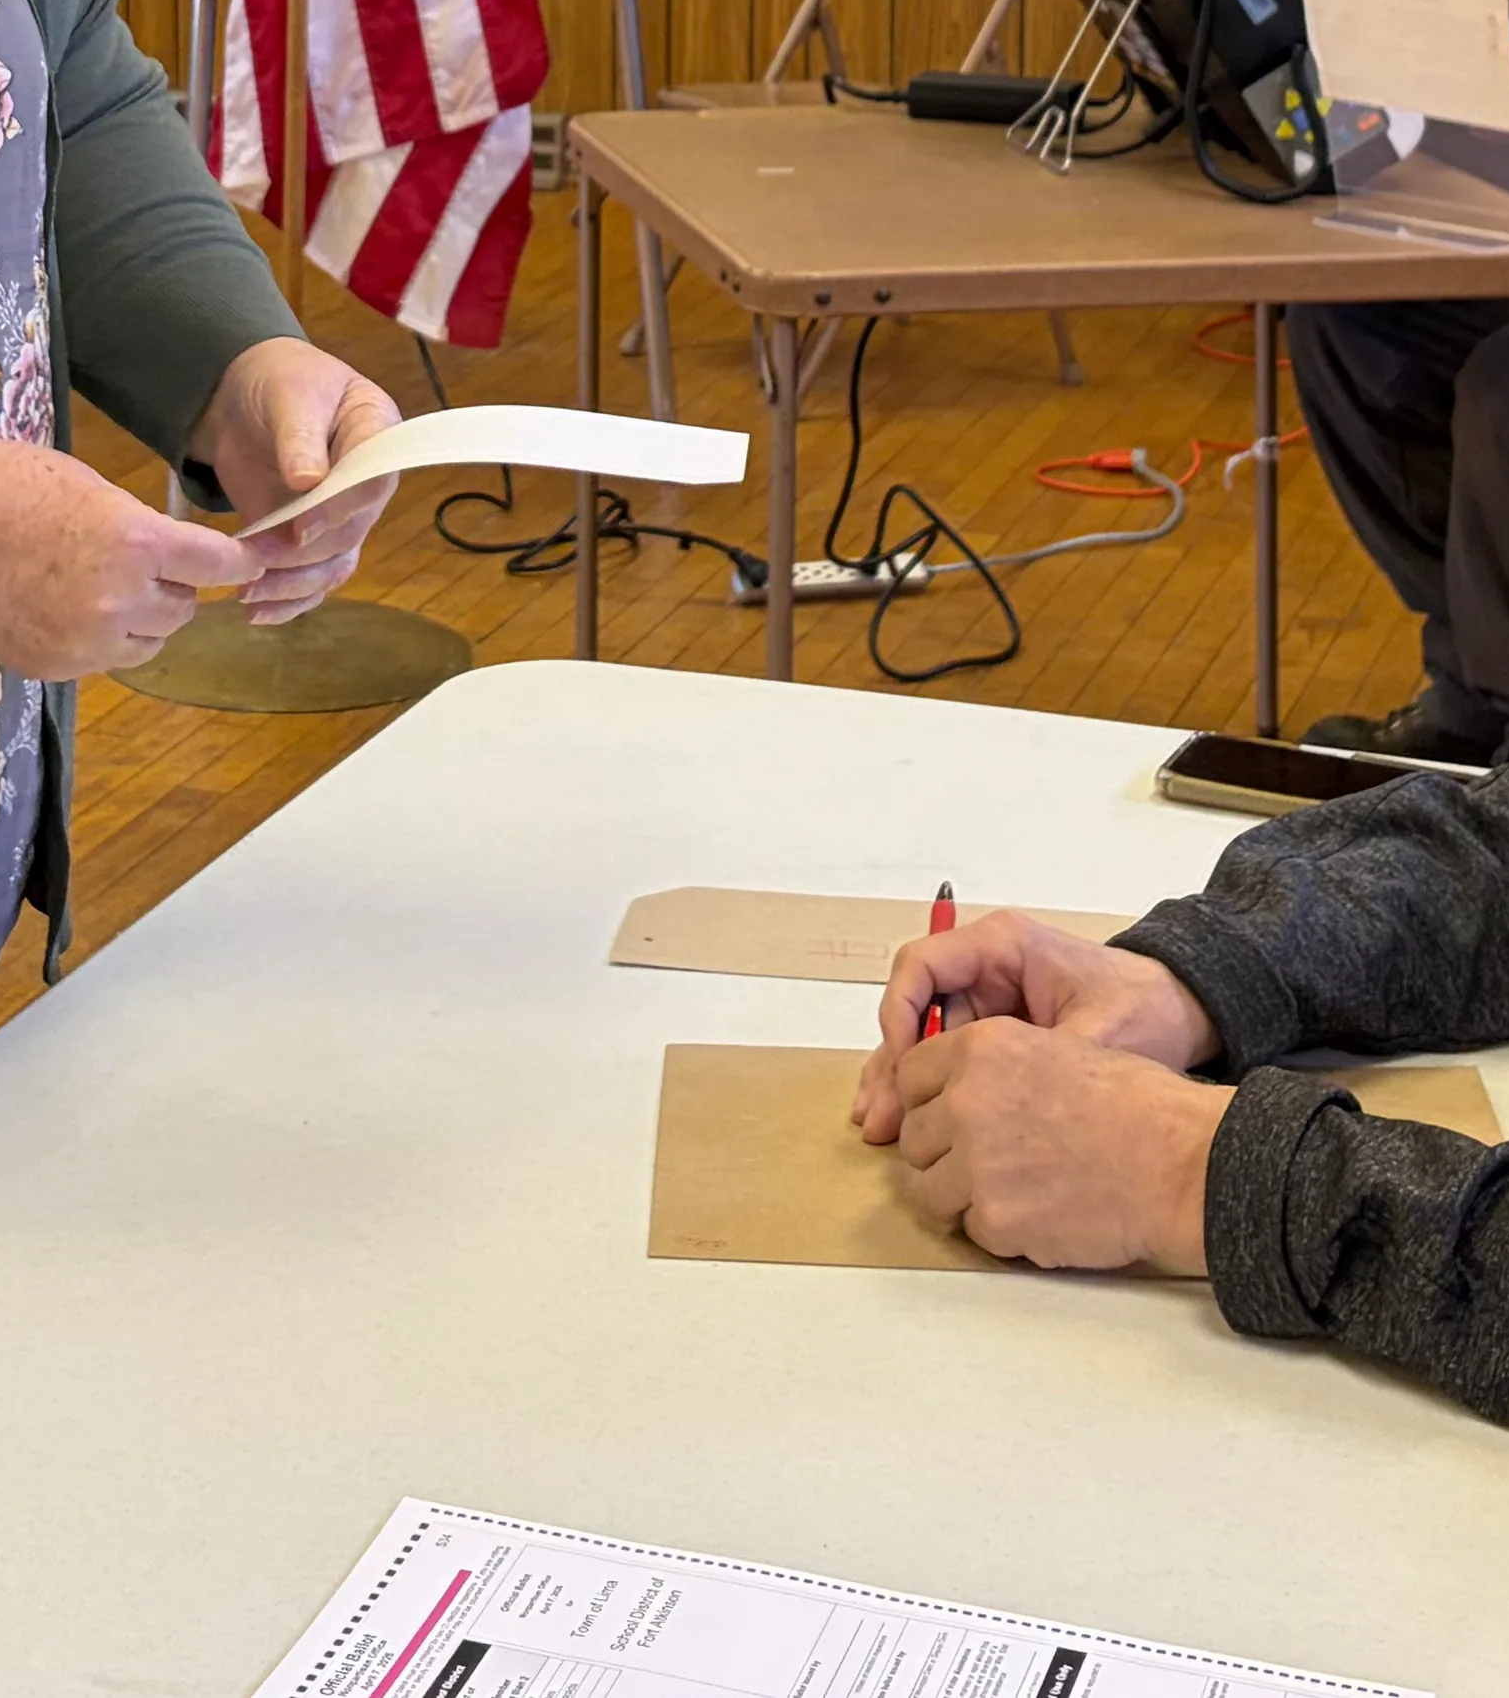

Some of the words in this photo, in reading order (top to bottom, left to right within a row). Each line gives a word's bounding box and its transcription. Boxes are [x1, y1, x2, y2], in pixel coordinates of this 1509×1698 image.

[590, 1602, 603, 1613] of
[593, 1580, 618, 1602] Lima
[570, 1614, 598, 1637] Town
[610, 1619, 640, 1651] School
[629, 1589, 661, 1619] District
[651, 1576, 665, 1588] of
[636, 1628, 660, 1648] Fort
[650, 1589, 683, 1629] Atkinson
[320, 1662, 354, 1696] Official
[346, 1634, 377, 1662] Ballot
